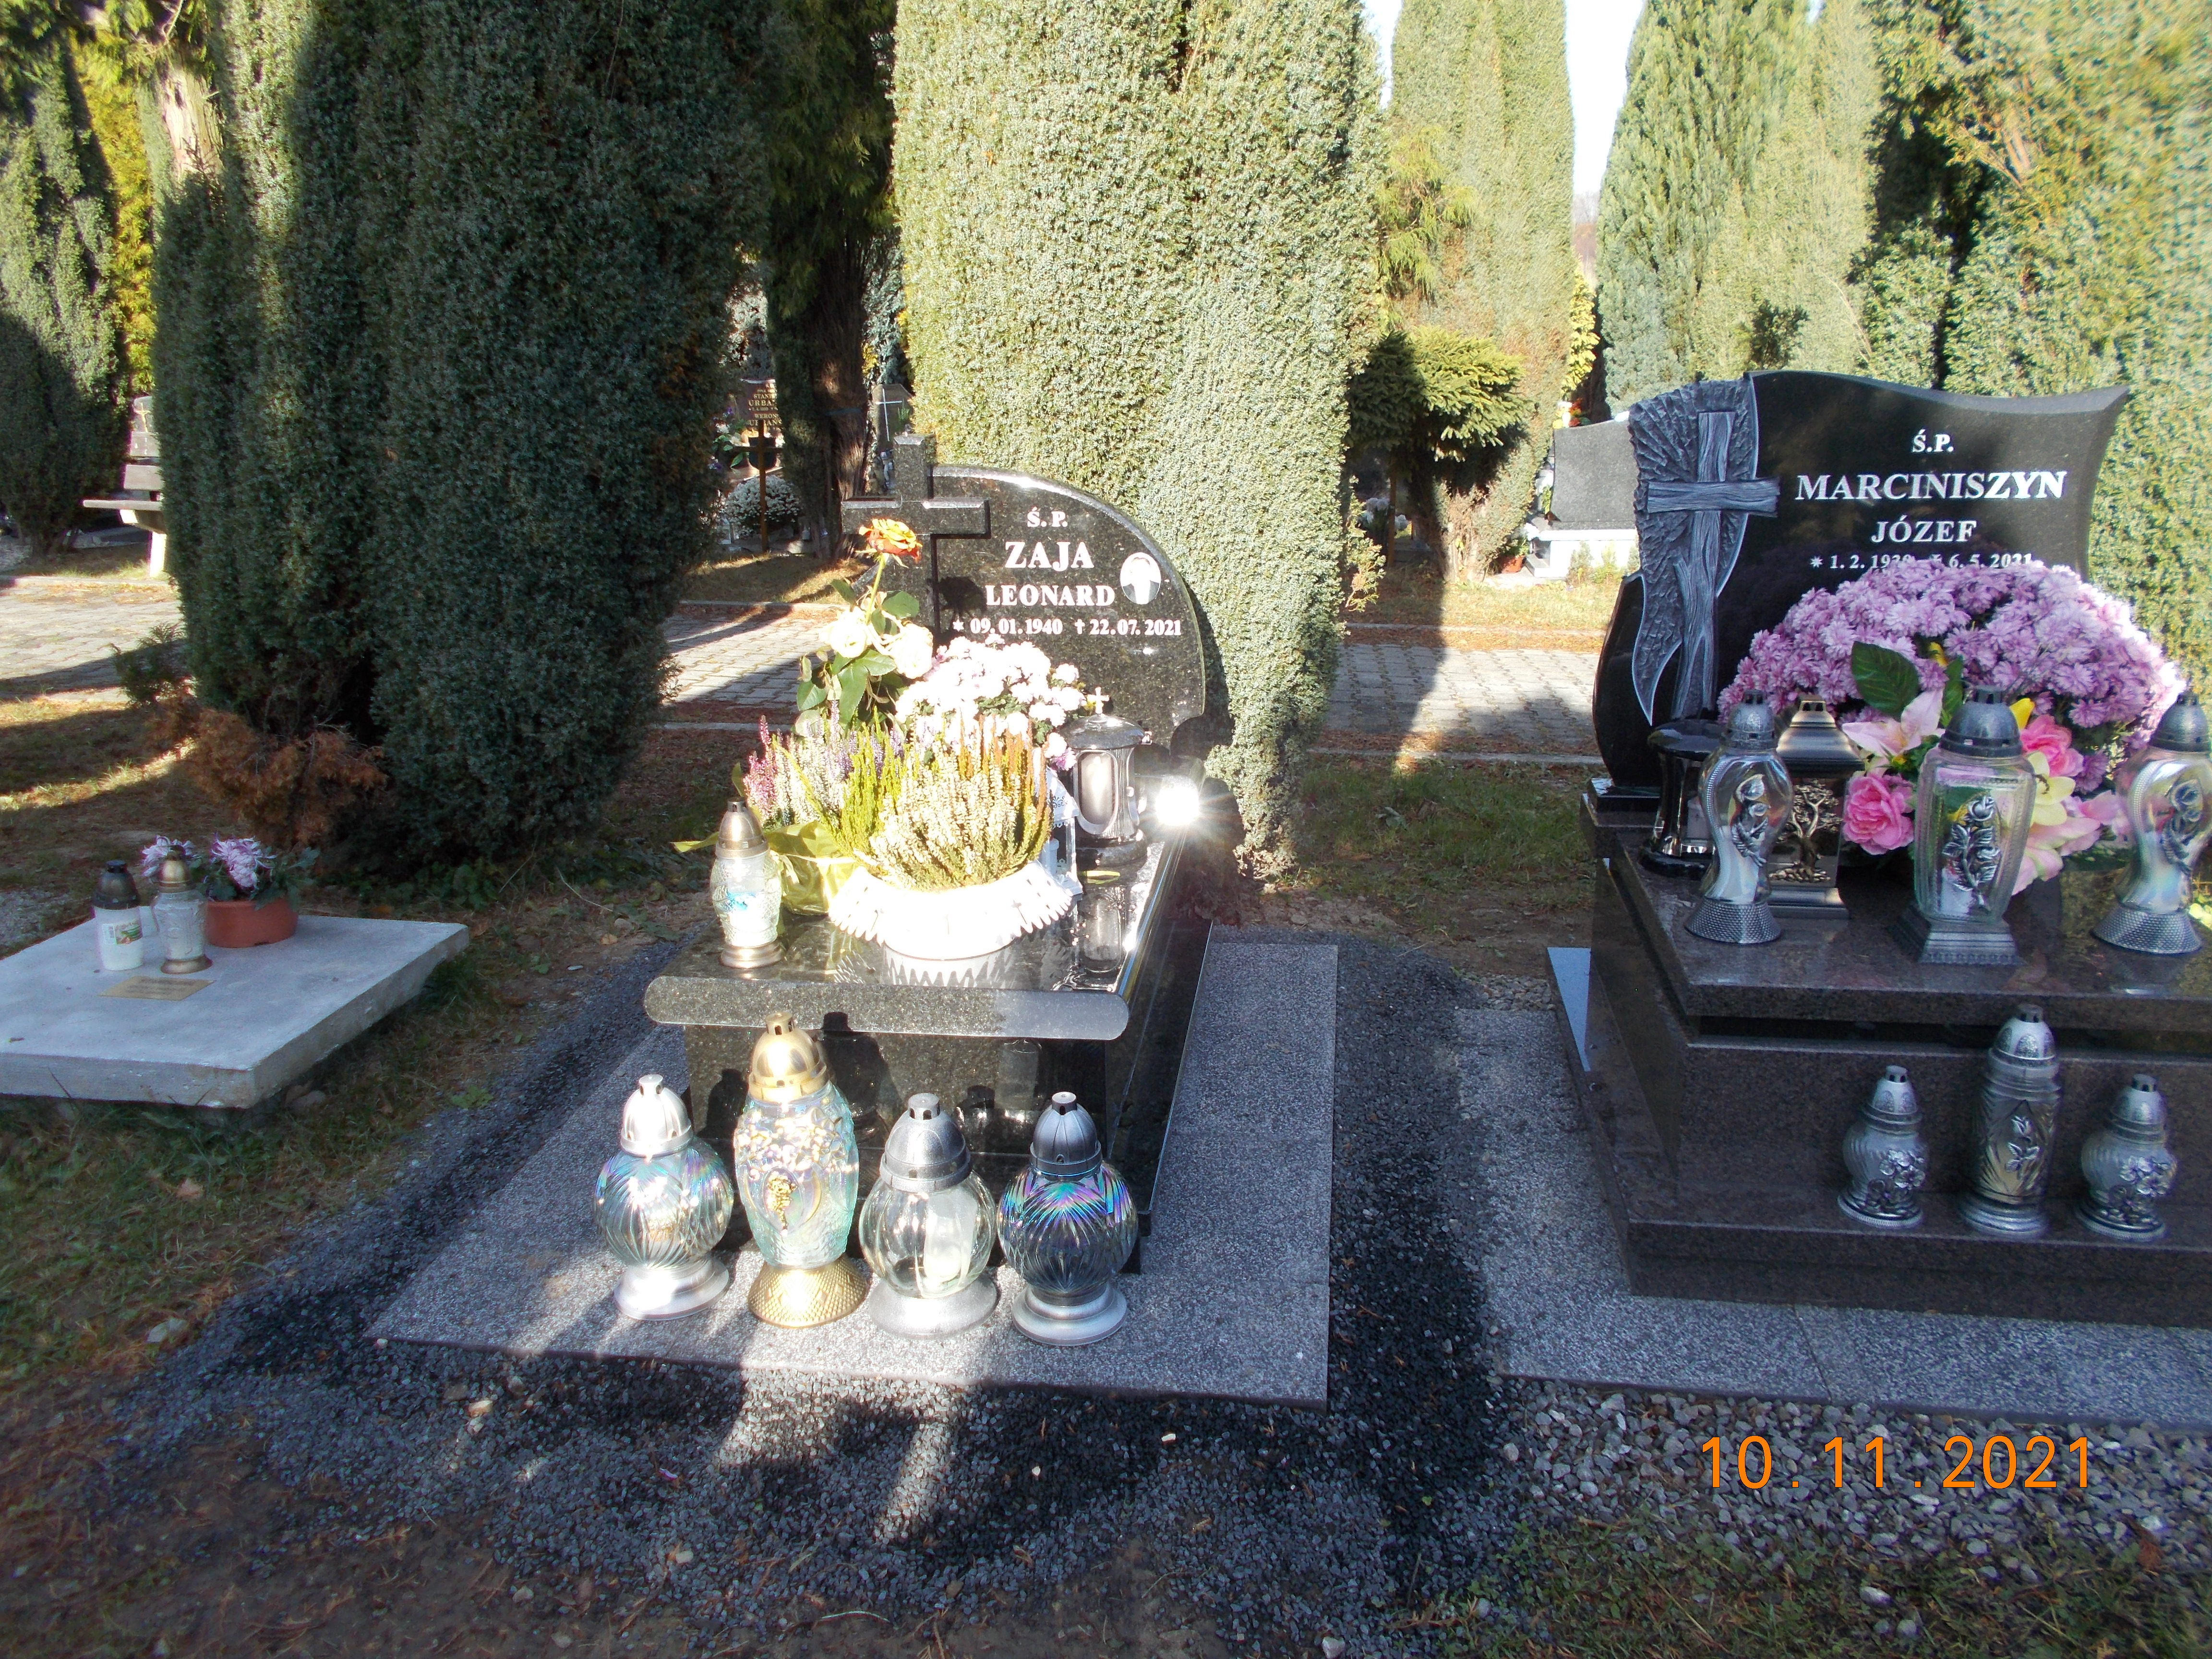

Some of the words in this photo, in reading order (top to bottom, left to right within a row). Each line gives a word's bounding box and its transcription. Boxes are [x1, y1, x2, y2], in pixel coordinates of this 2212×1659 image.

[1794, 470, 2068, 500] MARCINISZYN
[1871, 515, 1977, 543] JÓZEF
[1004, 541, 1095, 572] ZAJA
[985, 584, 1116, 606] LEONARD
